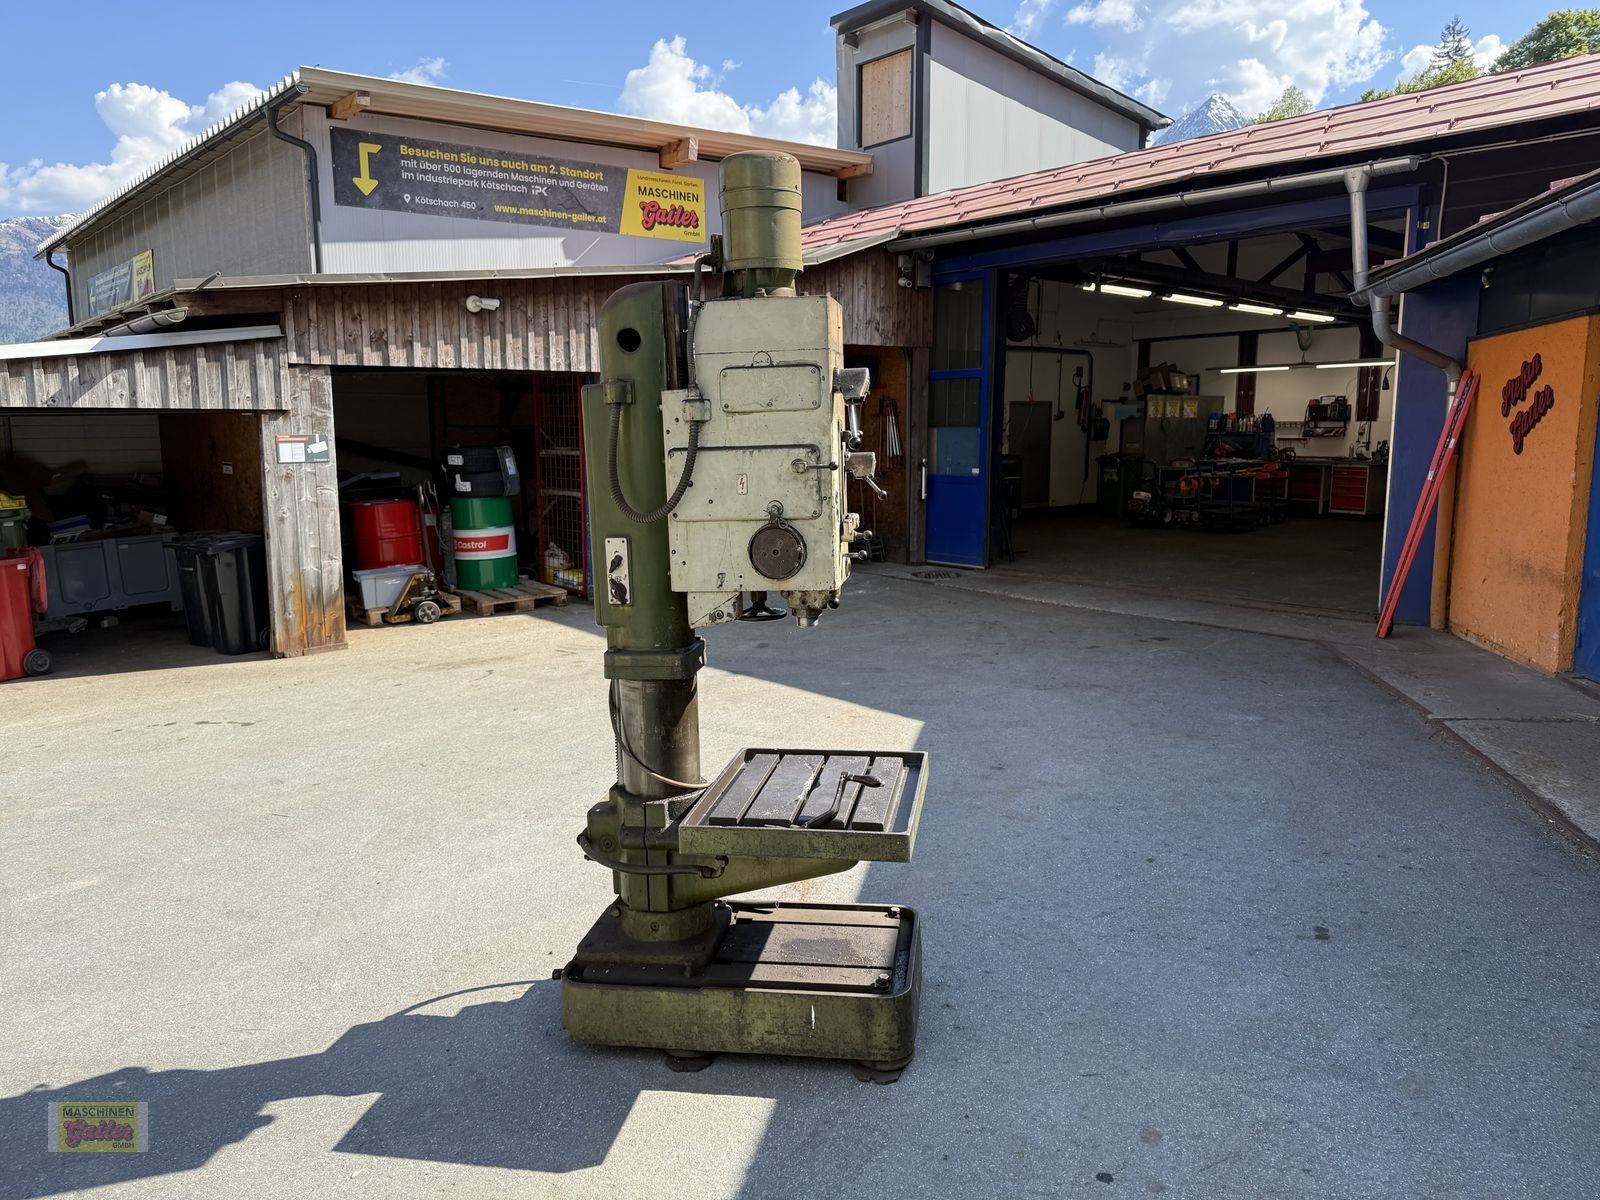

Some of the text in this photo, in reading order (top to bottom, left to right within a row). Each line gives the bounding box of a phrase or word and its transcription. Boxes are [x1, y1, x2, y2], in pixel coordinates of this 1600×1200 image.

[400, 144, 604, 181] Besuchen Sie uns auch am 2. Standort
[401, 159, 609, 193] mit über 500 lagernden Maschinen und Geräten
[401, 170, 415, 180] im
[416, 172, 479, 189] Industriepark
[481, 180, 528, 193] Kötschach
[415, 195, 476, 210] Kötschach 450
[638, 185, 699, 203] MASCHINEN
[494, 204, 607, 224] www.maschinen-gailer.at
[639, 200, 699, 231] Gailer
[457, 540, 487, 549] Castrol
